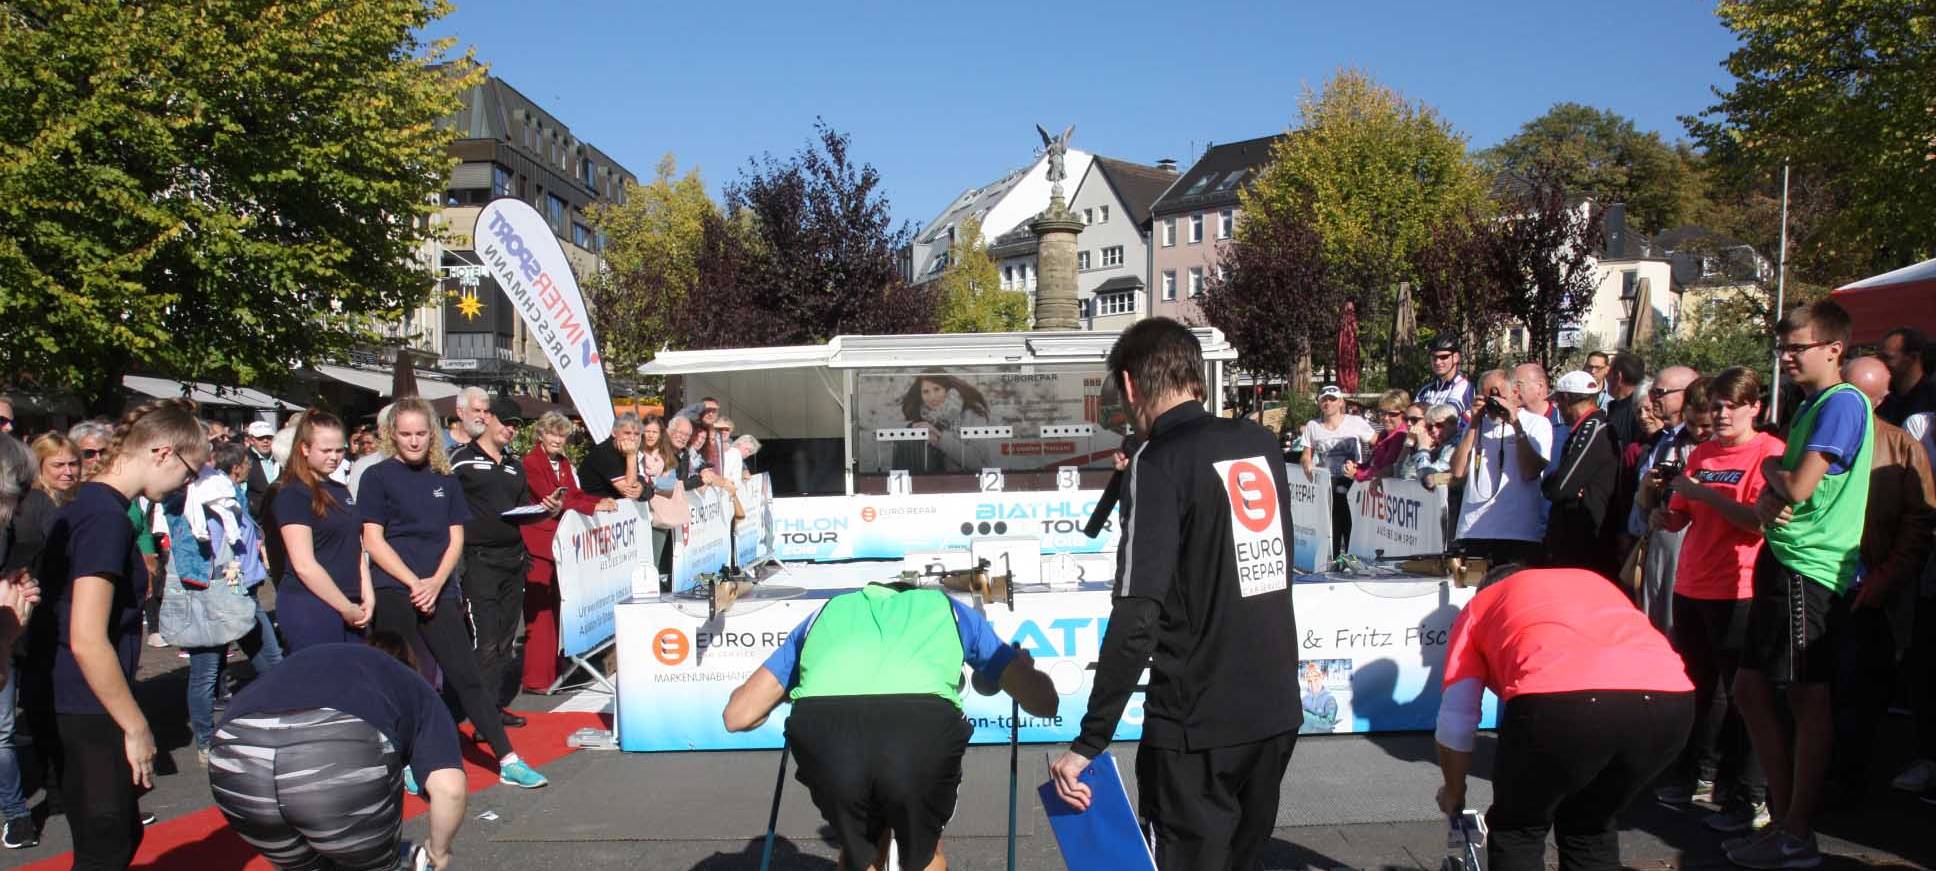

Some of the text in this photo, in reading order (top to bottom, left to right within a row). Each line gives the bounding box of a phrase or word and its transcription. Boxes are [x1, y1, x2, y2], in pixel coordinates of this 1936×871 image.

[893, 474, 905, 494] 1
[985, 472, 1000, 492] 2
[1062, 469, 1074, 489] 3
[976, 500, 1120, 521] BIATHLO
[775, 516, 849, 532] THLON
[582, 518, 638, 561] INTERSPORT
[782, 532, 838, 545] TOUR
[1236, 537, 1284, 562] EURO
[1240, 560, 1285, 583] REPAR
[697, 632, 789, 648] EURO RE
[1303, 624, 1454, 649] & Fritz Fisc
[966, 713, 1063, 728] on-tour.de
